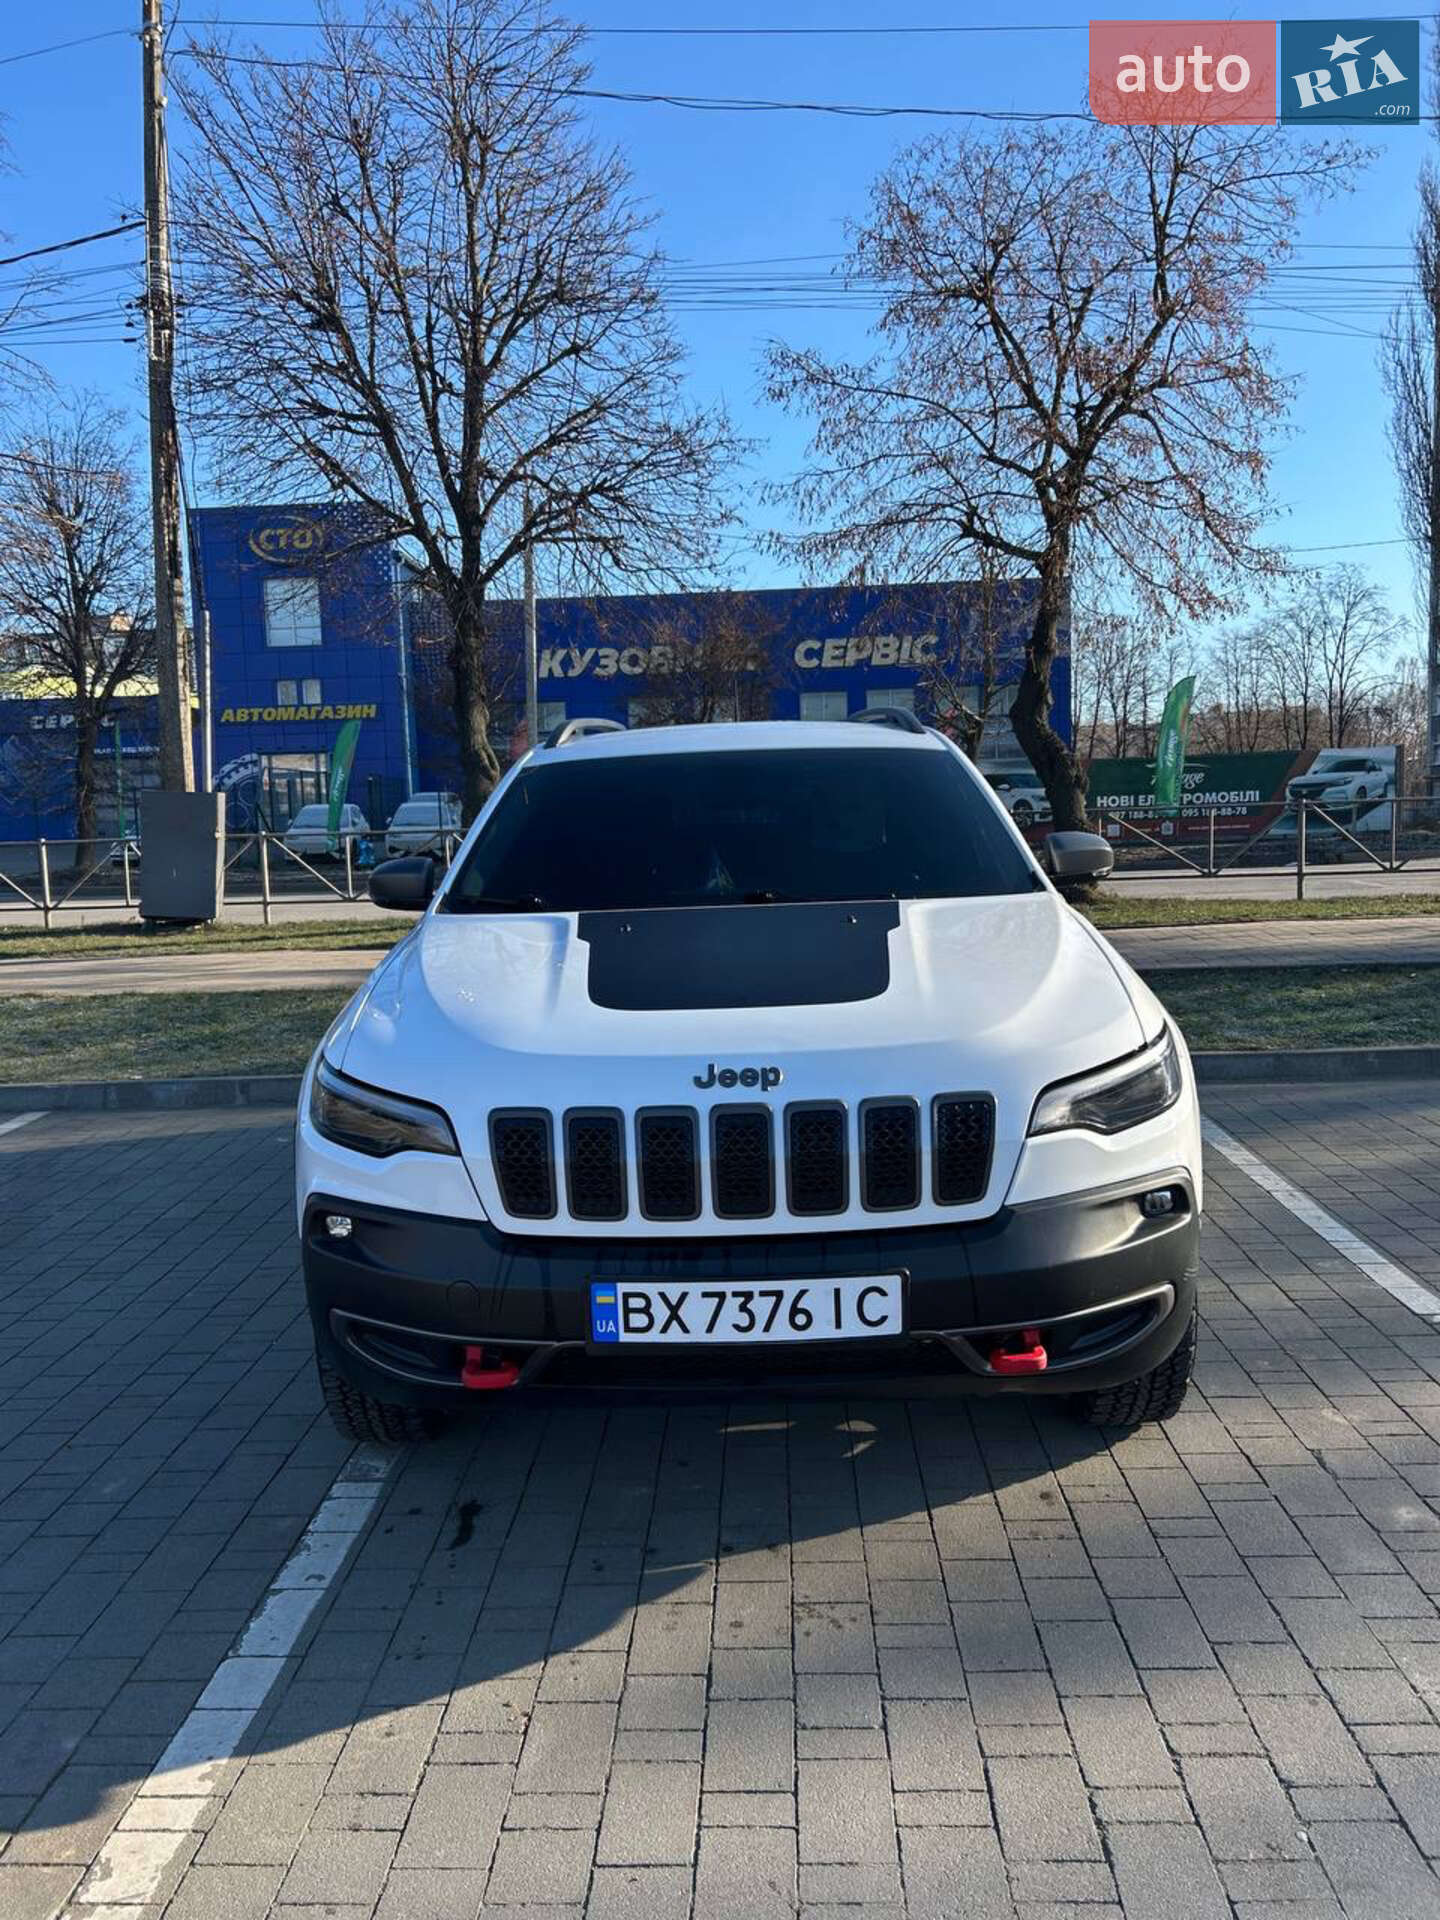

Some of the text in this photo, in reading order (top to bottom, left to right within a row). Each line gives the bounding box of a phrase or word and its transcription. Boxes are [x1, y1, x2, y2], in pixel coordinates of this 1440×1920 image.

[259, 528, 313, 550] СТО
[538, 634, 938, 678] КУЗОВ СЕРВІС
[30, 714, 115, 729] СЕРС
[220, 704, 377, 722] АВТОМАГАЗИН
[1097, 790, 1260, 807] НОВІ ЕЛРОМОБІЛІ
[693, 1063, 783, 1091] Jeep
[621, 1286, 889, 1334] BX 7376 IC
[596, 1320, 616, 1334] UA
